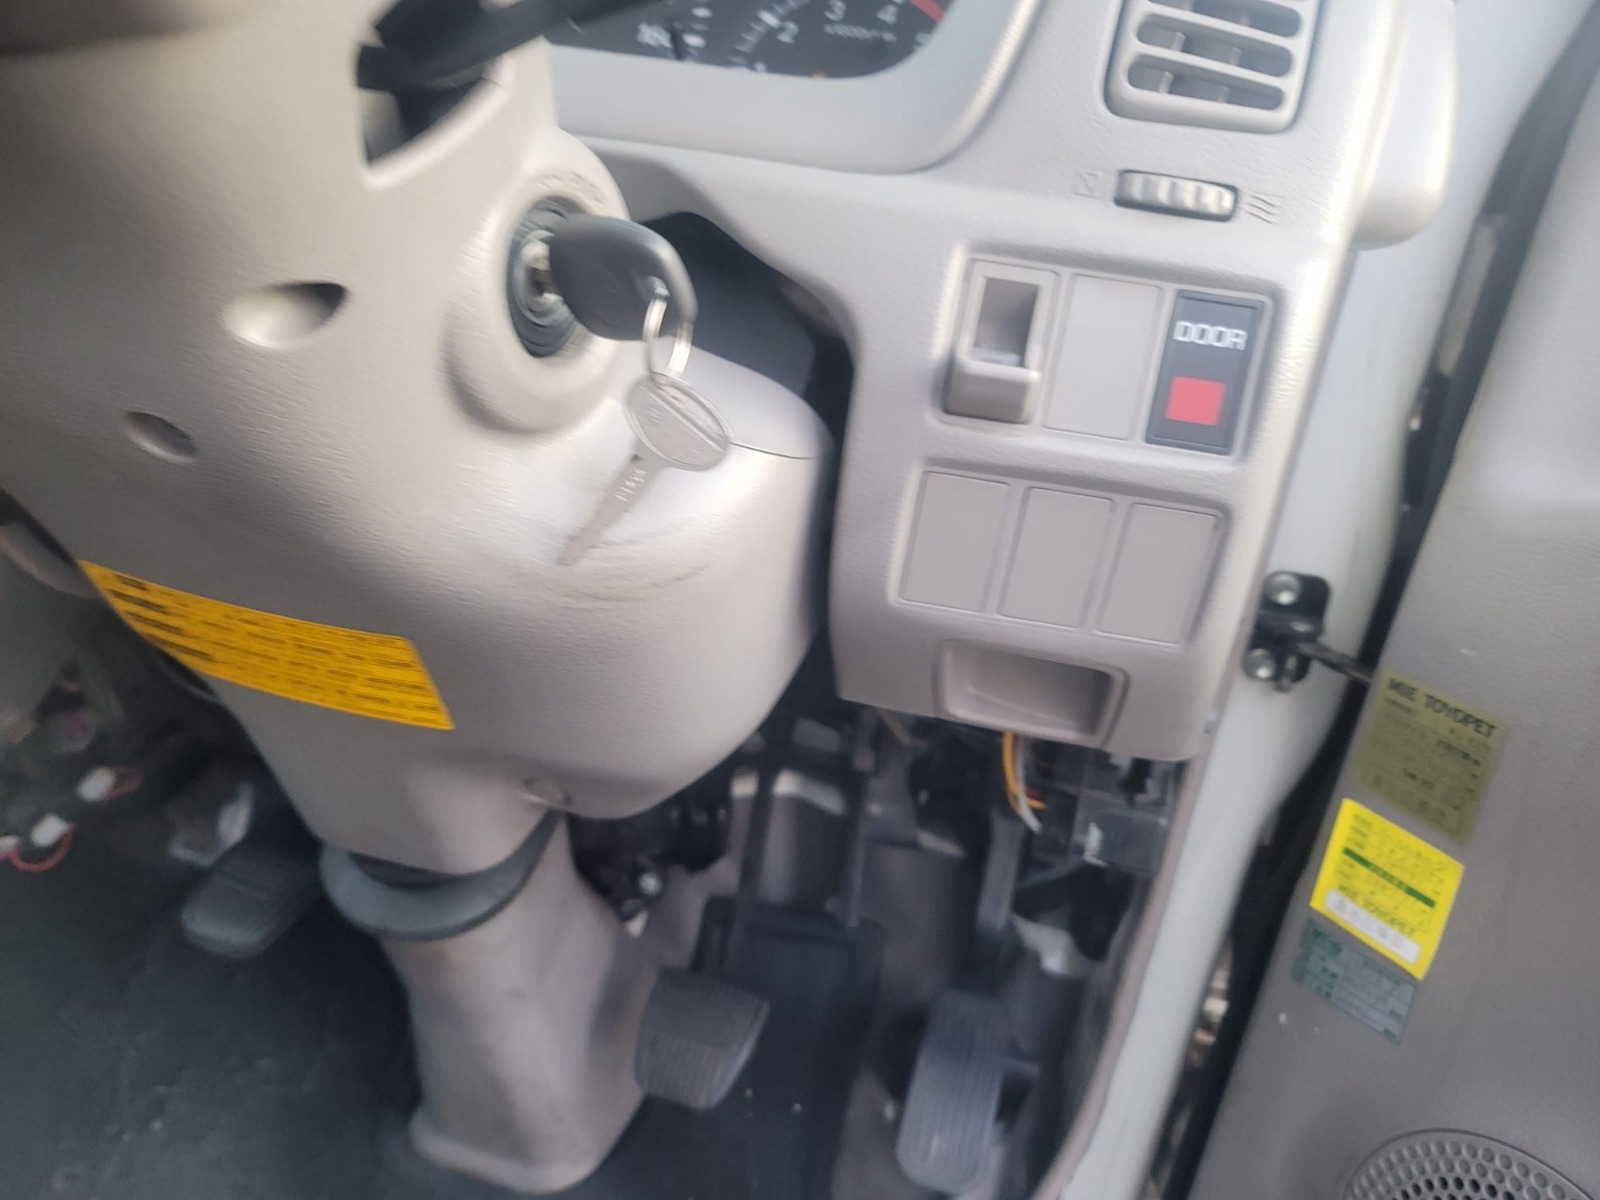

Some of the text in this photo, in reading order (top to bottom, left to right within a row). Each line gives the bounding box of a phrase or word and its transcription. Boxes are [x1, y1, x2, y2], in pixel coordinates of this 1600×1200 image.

[876, 4, 898, 25] 4
[776, 21, 799, 43] 2
[1173, 320, 1248, 350] DOOR
